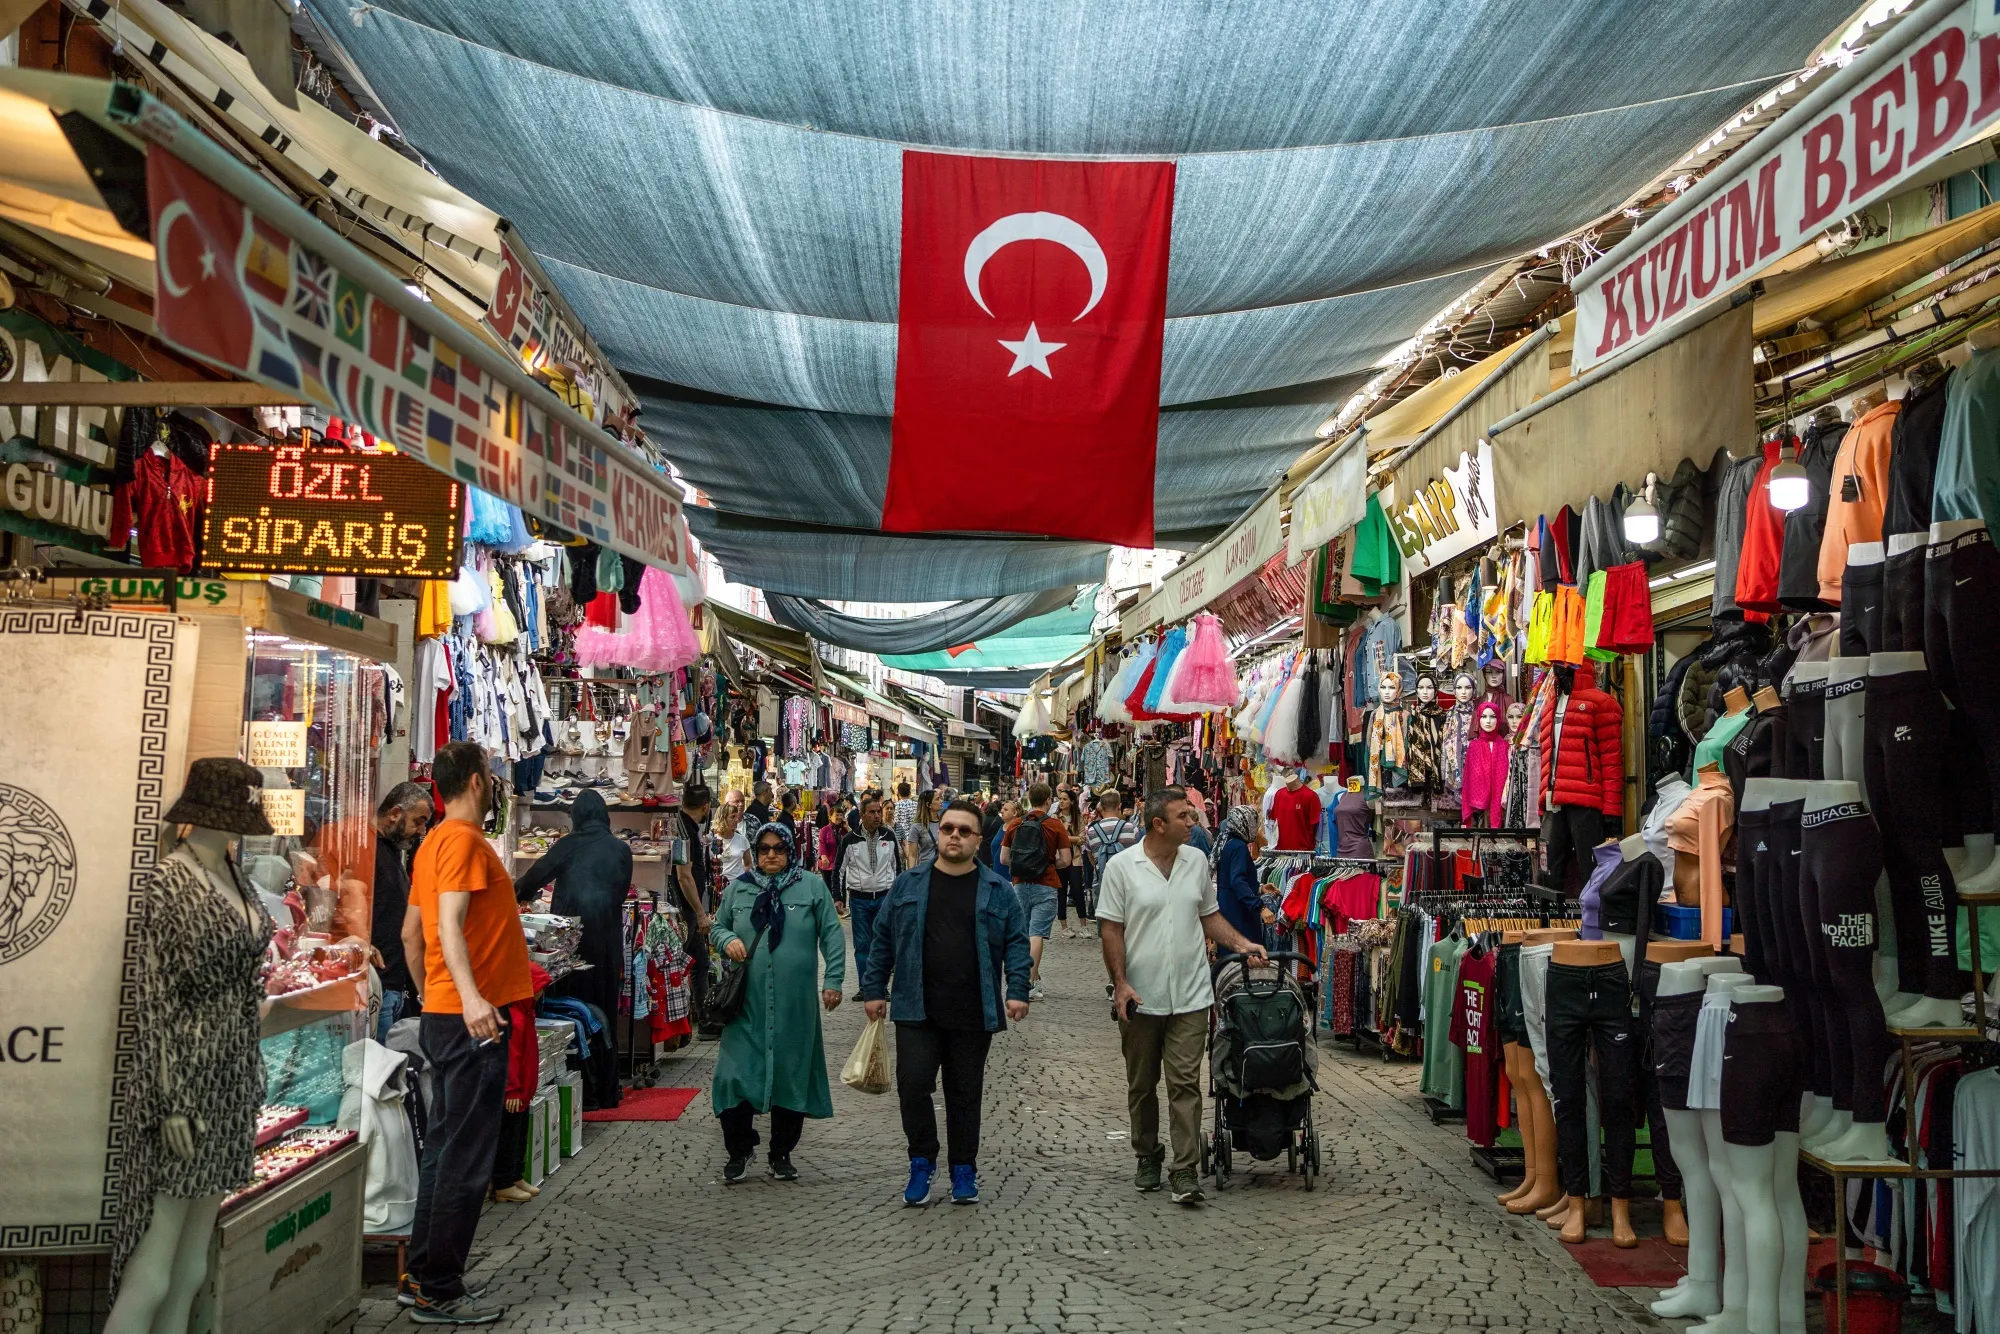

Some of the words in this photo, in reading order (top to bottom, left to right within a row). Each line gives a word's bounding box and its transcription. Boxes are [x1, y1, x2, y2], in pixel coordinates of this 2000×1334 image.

[1596, 154, 1781, 358] KUZUM
[270, 446, 383, 501] ÖZEL
[6, 462, 114, 537] GÜMÜ
[222, 506, 428, 571] SİPARİŞ
[1812, 680, 1827, 691] PRO
[1836, 680, 1864, 695] PRO
[251, 758, 299, 766] YAPILIR
[262, 802, 293, 810] URUN
[1802, 812, 1820, 825] RTH
[1822, 804, 1860, 820] FACE
[1920, 874, 1945, 910] AIR
[1839, 914, 1865, 925] THE
[1821, 923, 1865, 936] NORTH
[1927, 914, 1949, 956] NIKE
[1832, 936, 1866, 947] FACE
